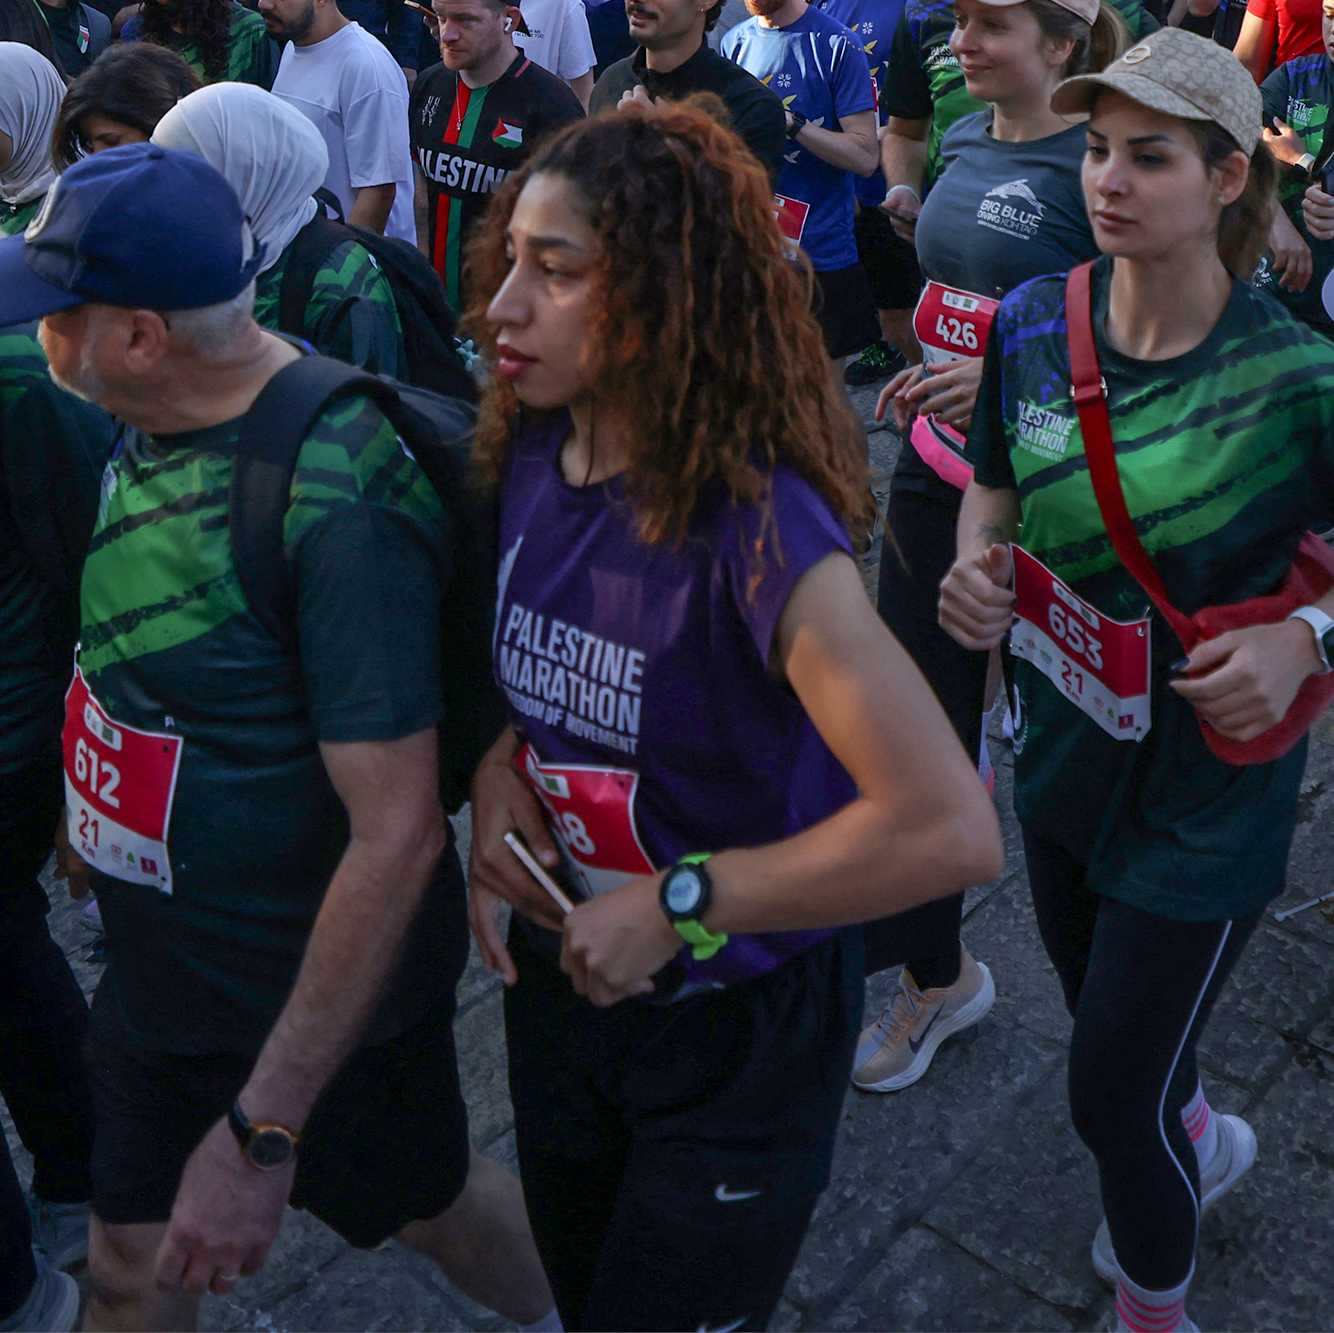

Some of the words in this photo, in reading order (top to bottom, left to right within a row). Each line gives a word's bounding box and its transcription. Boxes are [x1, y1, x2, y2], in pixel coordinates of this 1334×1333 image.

[976, 210, 1001, 224] DIVING
[979, 199, 1001, 214] BIG
[1000, 205, 1042, 228] BLUE
[935, 314, 979, 350] 426
[503, 603, 646, 695] PALESTINE
[1049, 603, 1103, 670] 653
[500, 644, 642, 736] MARATHON
[1061, 661, 1083, 695] 21
[545, 705, 565, 726] OF
[565, 712, 639, 756] MOVEMENT
[74, 737, 121, 810] 612
[78, 808, 99, 848] 21
[81, 839, 96, 860] Km
